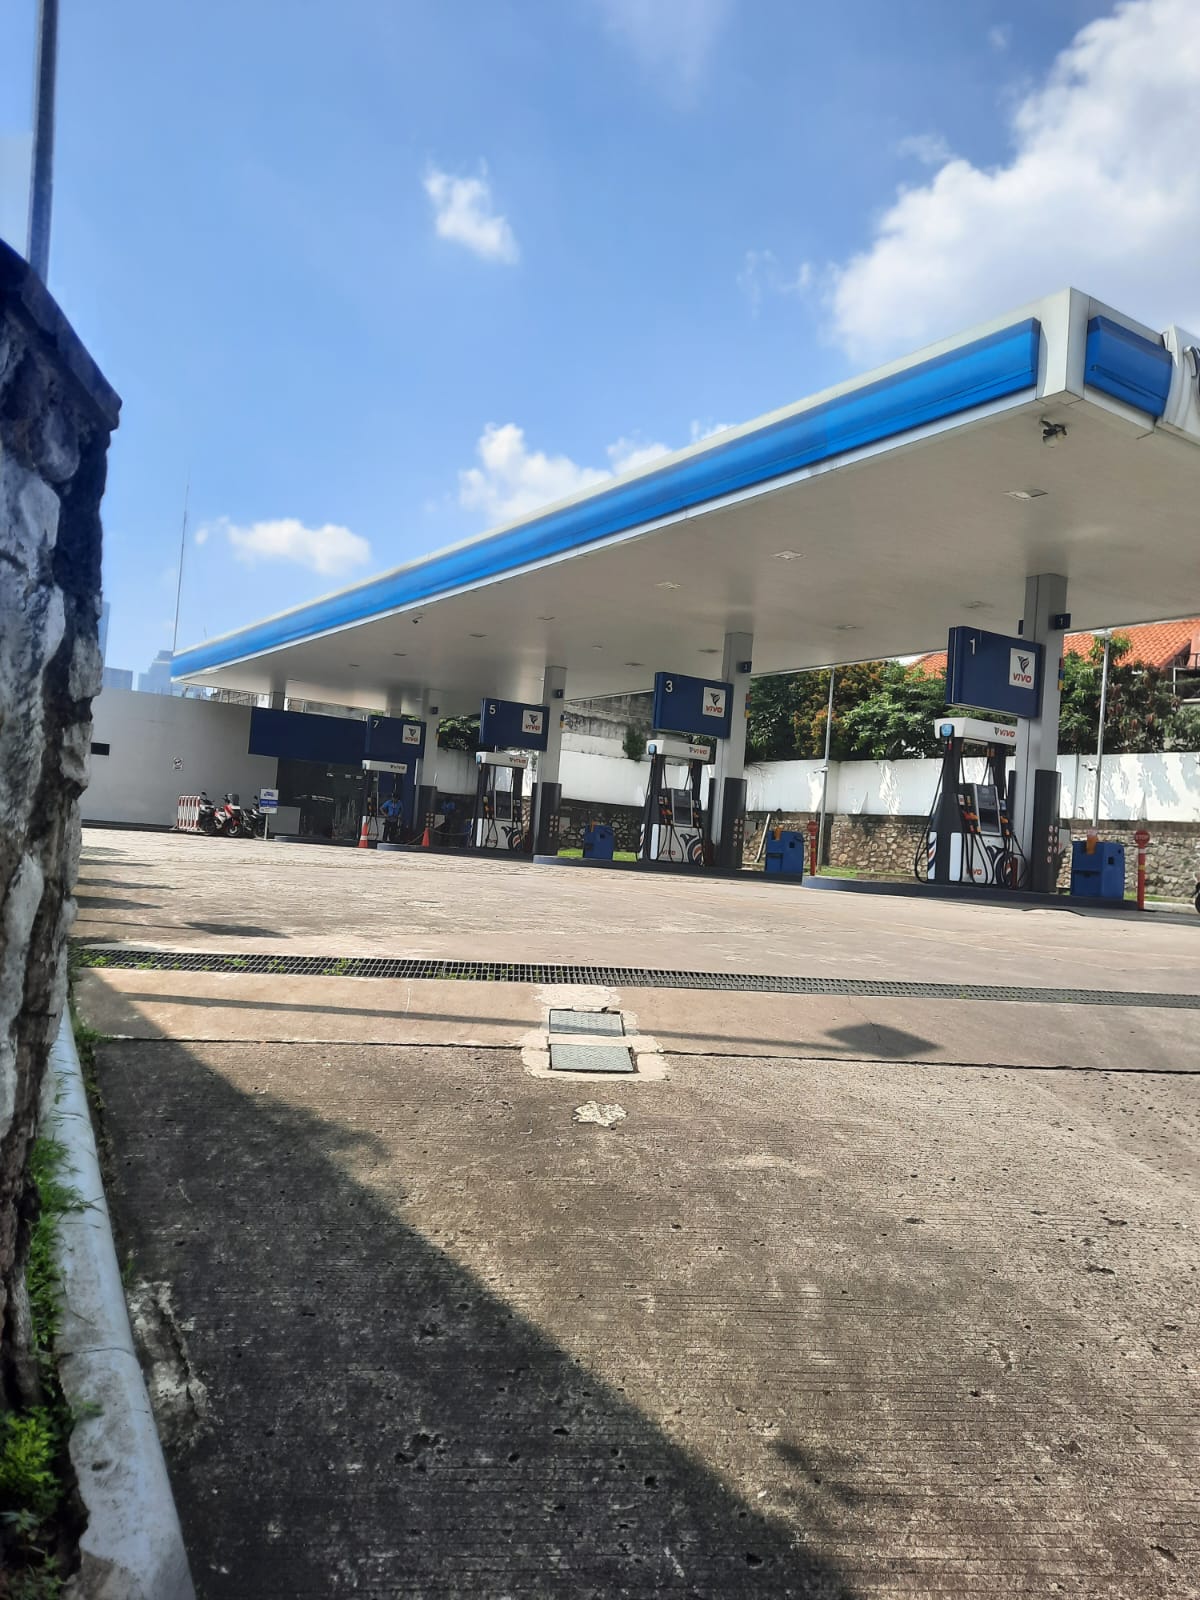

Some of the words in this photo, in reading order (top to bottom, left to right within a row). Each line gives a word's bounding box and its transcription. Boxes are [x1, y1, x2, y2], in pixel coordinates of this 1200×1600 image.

[969, 637, 976, 656] 1
[1013, 672, 1032, 683] VIVO
[665, 680, 673, 693] 3
[489, 704, 496, 715] 5
[705, 705, 723, 713] VIVO
[373, 720, 379, 728] 7
[999, 729, 1016, 738] VIVO
